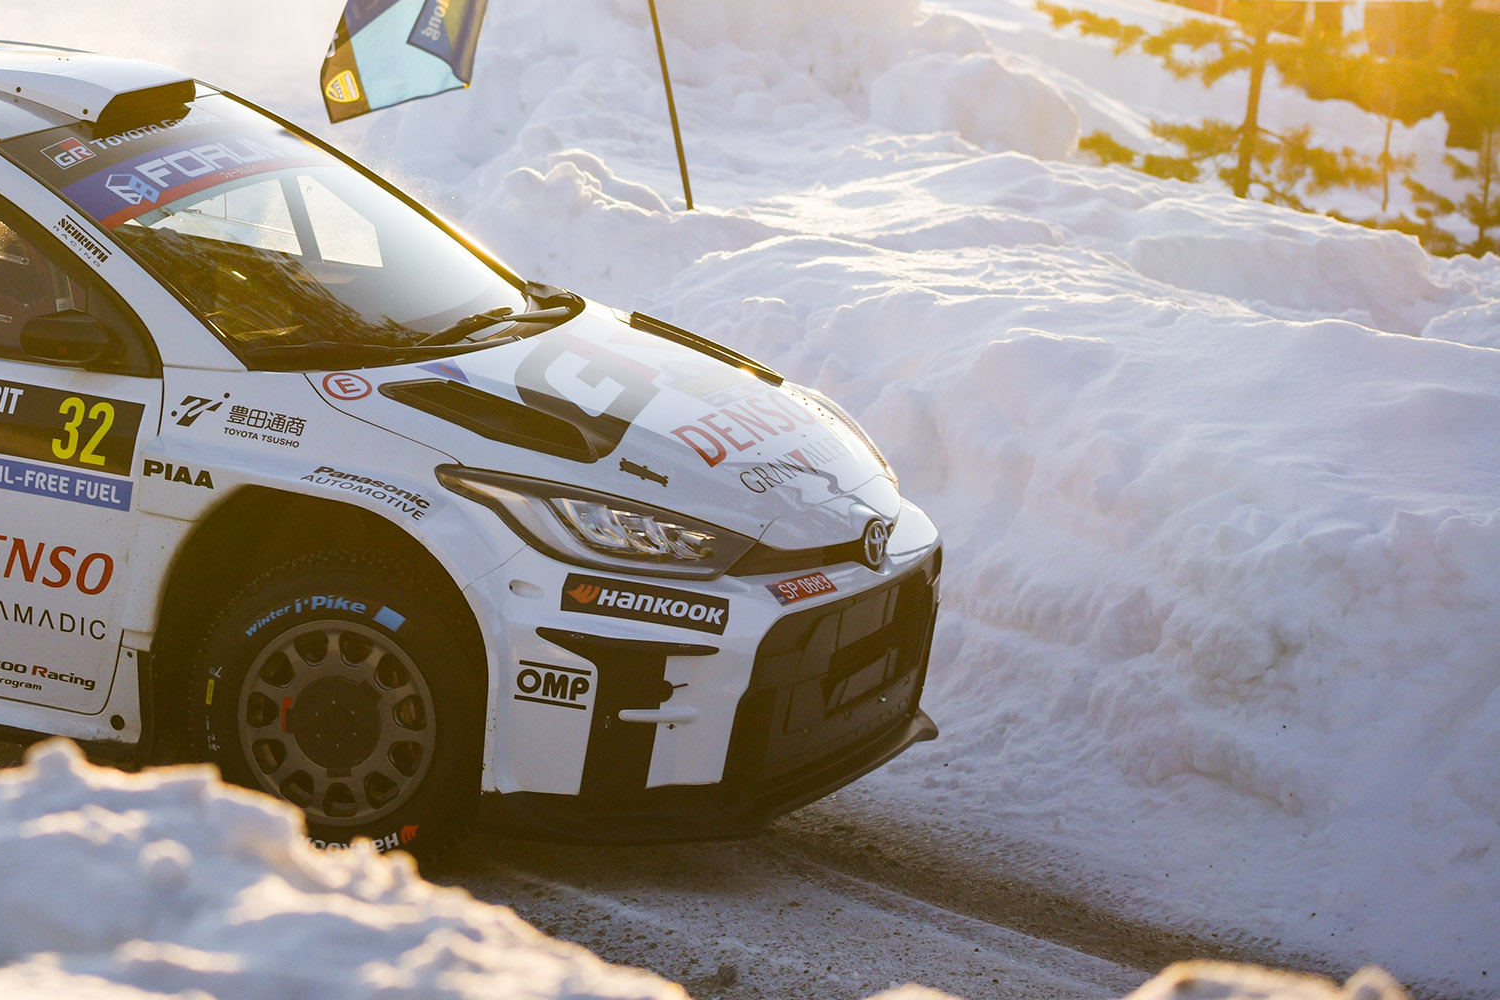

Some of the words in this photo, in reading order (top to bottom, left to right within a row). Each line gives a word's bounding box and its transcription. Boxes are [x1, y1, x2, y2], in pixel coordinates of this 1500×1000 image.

[53, 140, 93, 170] GR
[89, 124, 164, 150] TOYOTA
[53, 224, 101, 268] RACING
[57, 217, 109, 264] SCHROTH
[51, 396, 116, 466] 32
[223, 427, 259, 441] TOYOTA
[261, 434, 301, 448] TSUSHO
[226, 404, 308, 437] 豊田通商
[669, 389, 817, 469] DENSO
[74, 479, 122, 504] FUEL
[143, 458, 215, 490] PIAA
[313, 465, 431, 511] Panasonic
[301, 474, 426, 521] AUTOMOTIVE
[778, 581, 798, 601] SP
[798, 573, 832, 596] 0683
[31, 664, 97, 691] Racing
[516, 668, 591, 702] OMP
